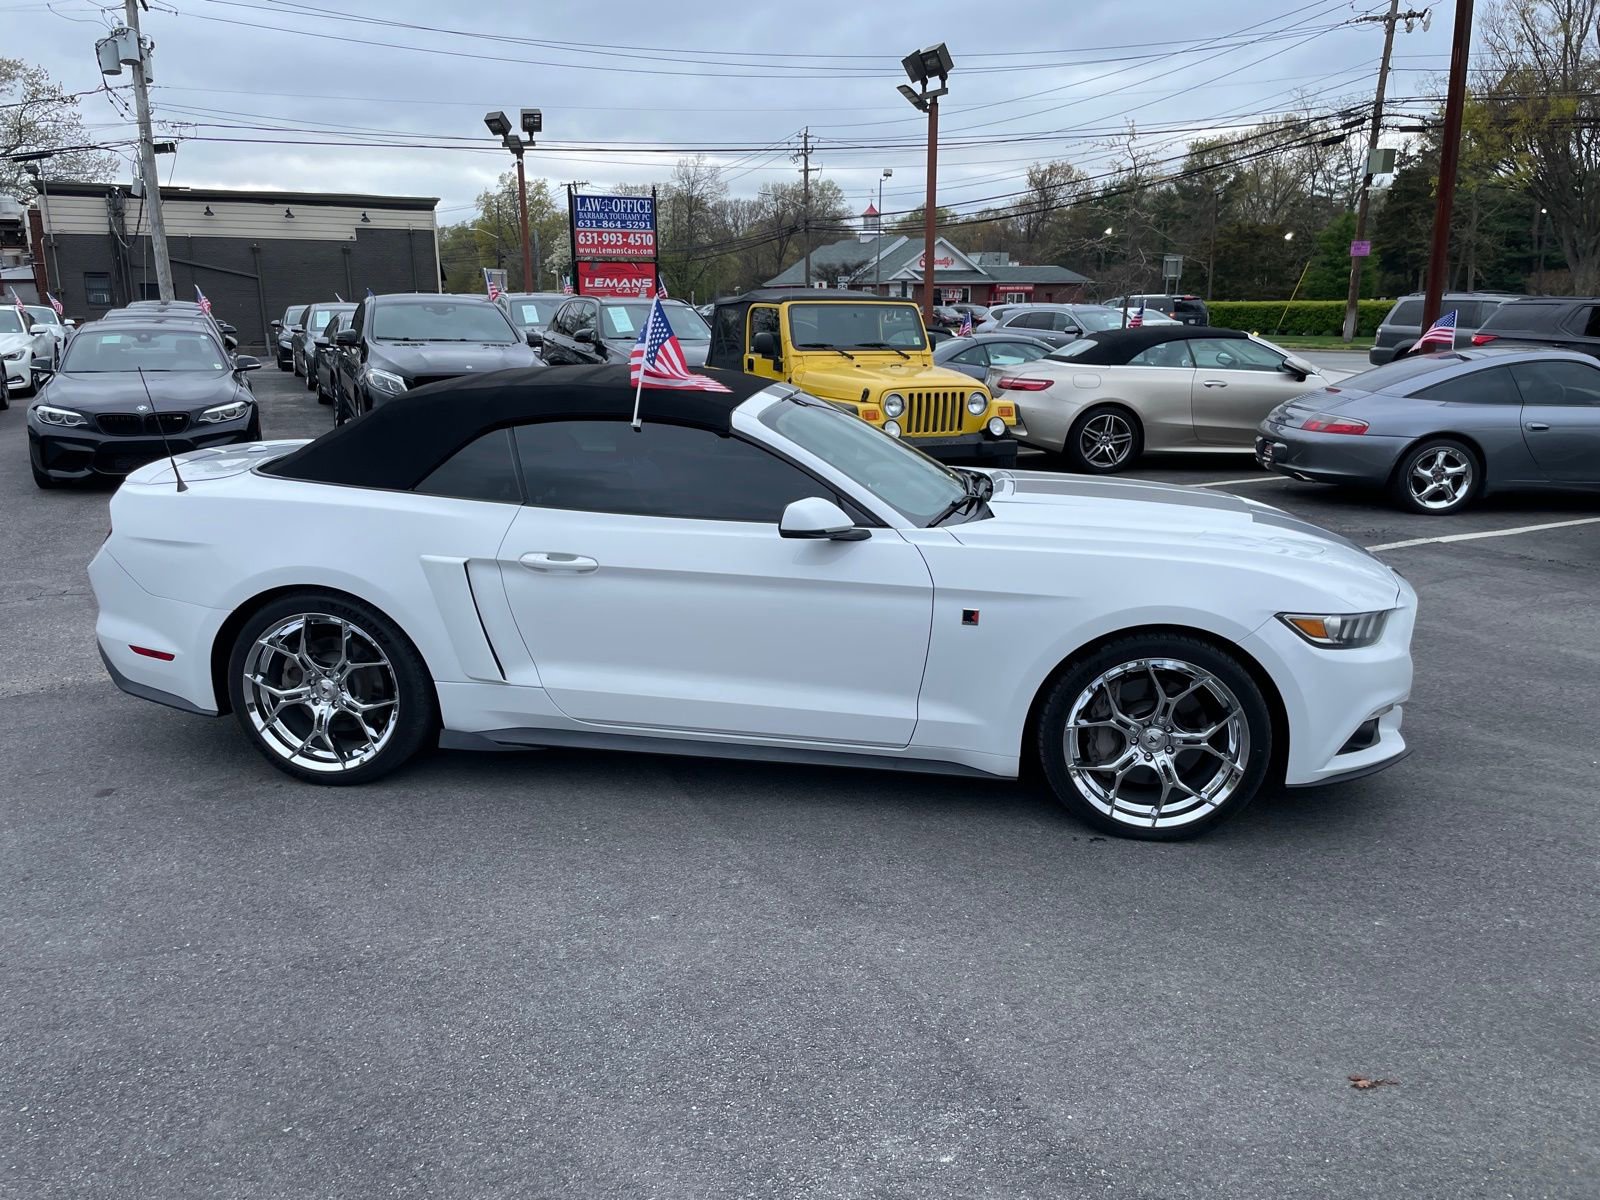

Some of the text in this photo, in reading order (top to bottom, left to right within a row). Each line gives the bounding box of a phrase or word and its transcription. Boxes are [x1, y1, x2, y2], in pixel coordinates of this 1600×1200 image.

[576, 197, 651, 213] LAW OFFICE
[578, 219, 651, 229] 631-864-5291
[578, 232, 654, 246] 631-993-4510
[578, 246, 654, 255] www.LemansCars.com
[584, 277, 653, 288] LEMANS
